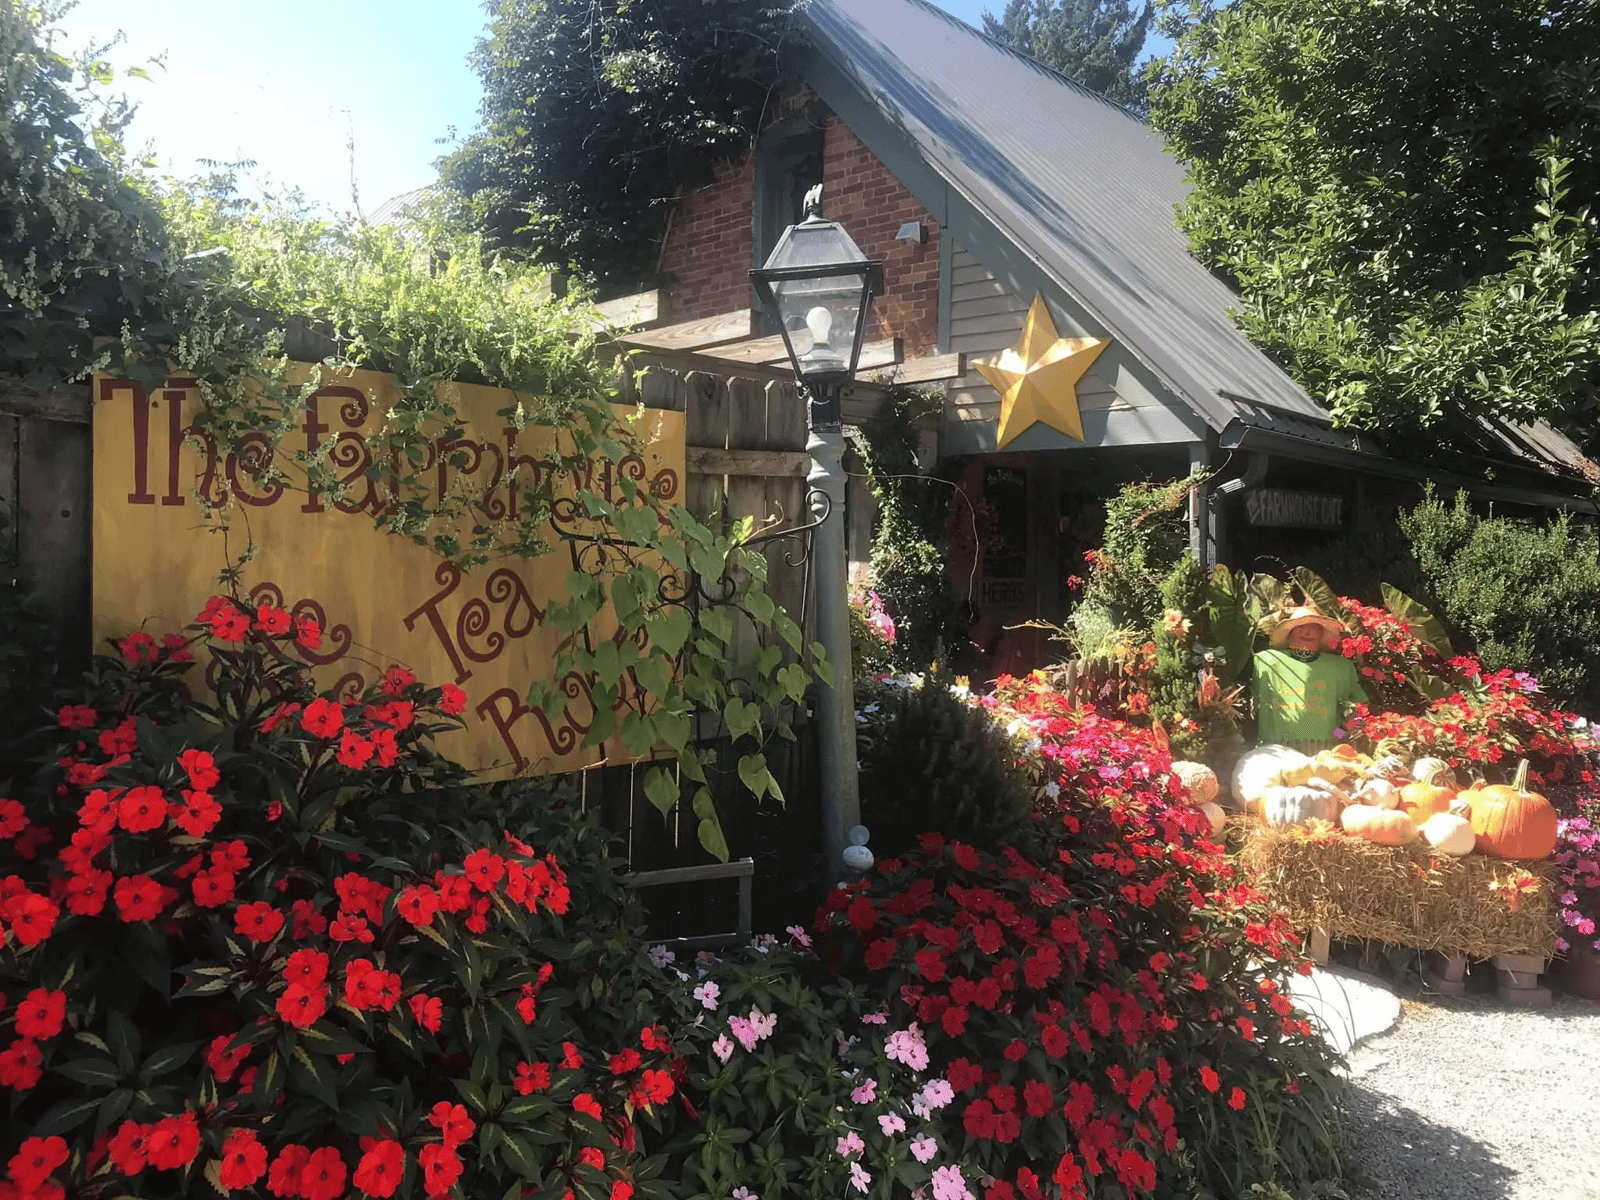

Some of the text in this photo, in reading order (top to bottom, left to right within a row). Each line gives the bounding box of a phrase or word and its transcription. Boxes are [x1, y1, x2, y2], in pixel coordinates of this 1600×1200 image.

[100, 379, 284, 508] The
[1259, 489, 1320, 524] FARMHOUSE
[404, 561, 546, 685] Tea
[475, 624, 674, 775] Ro
